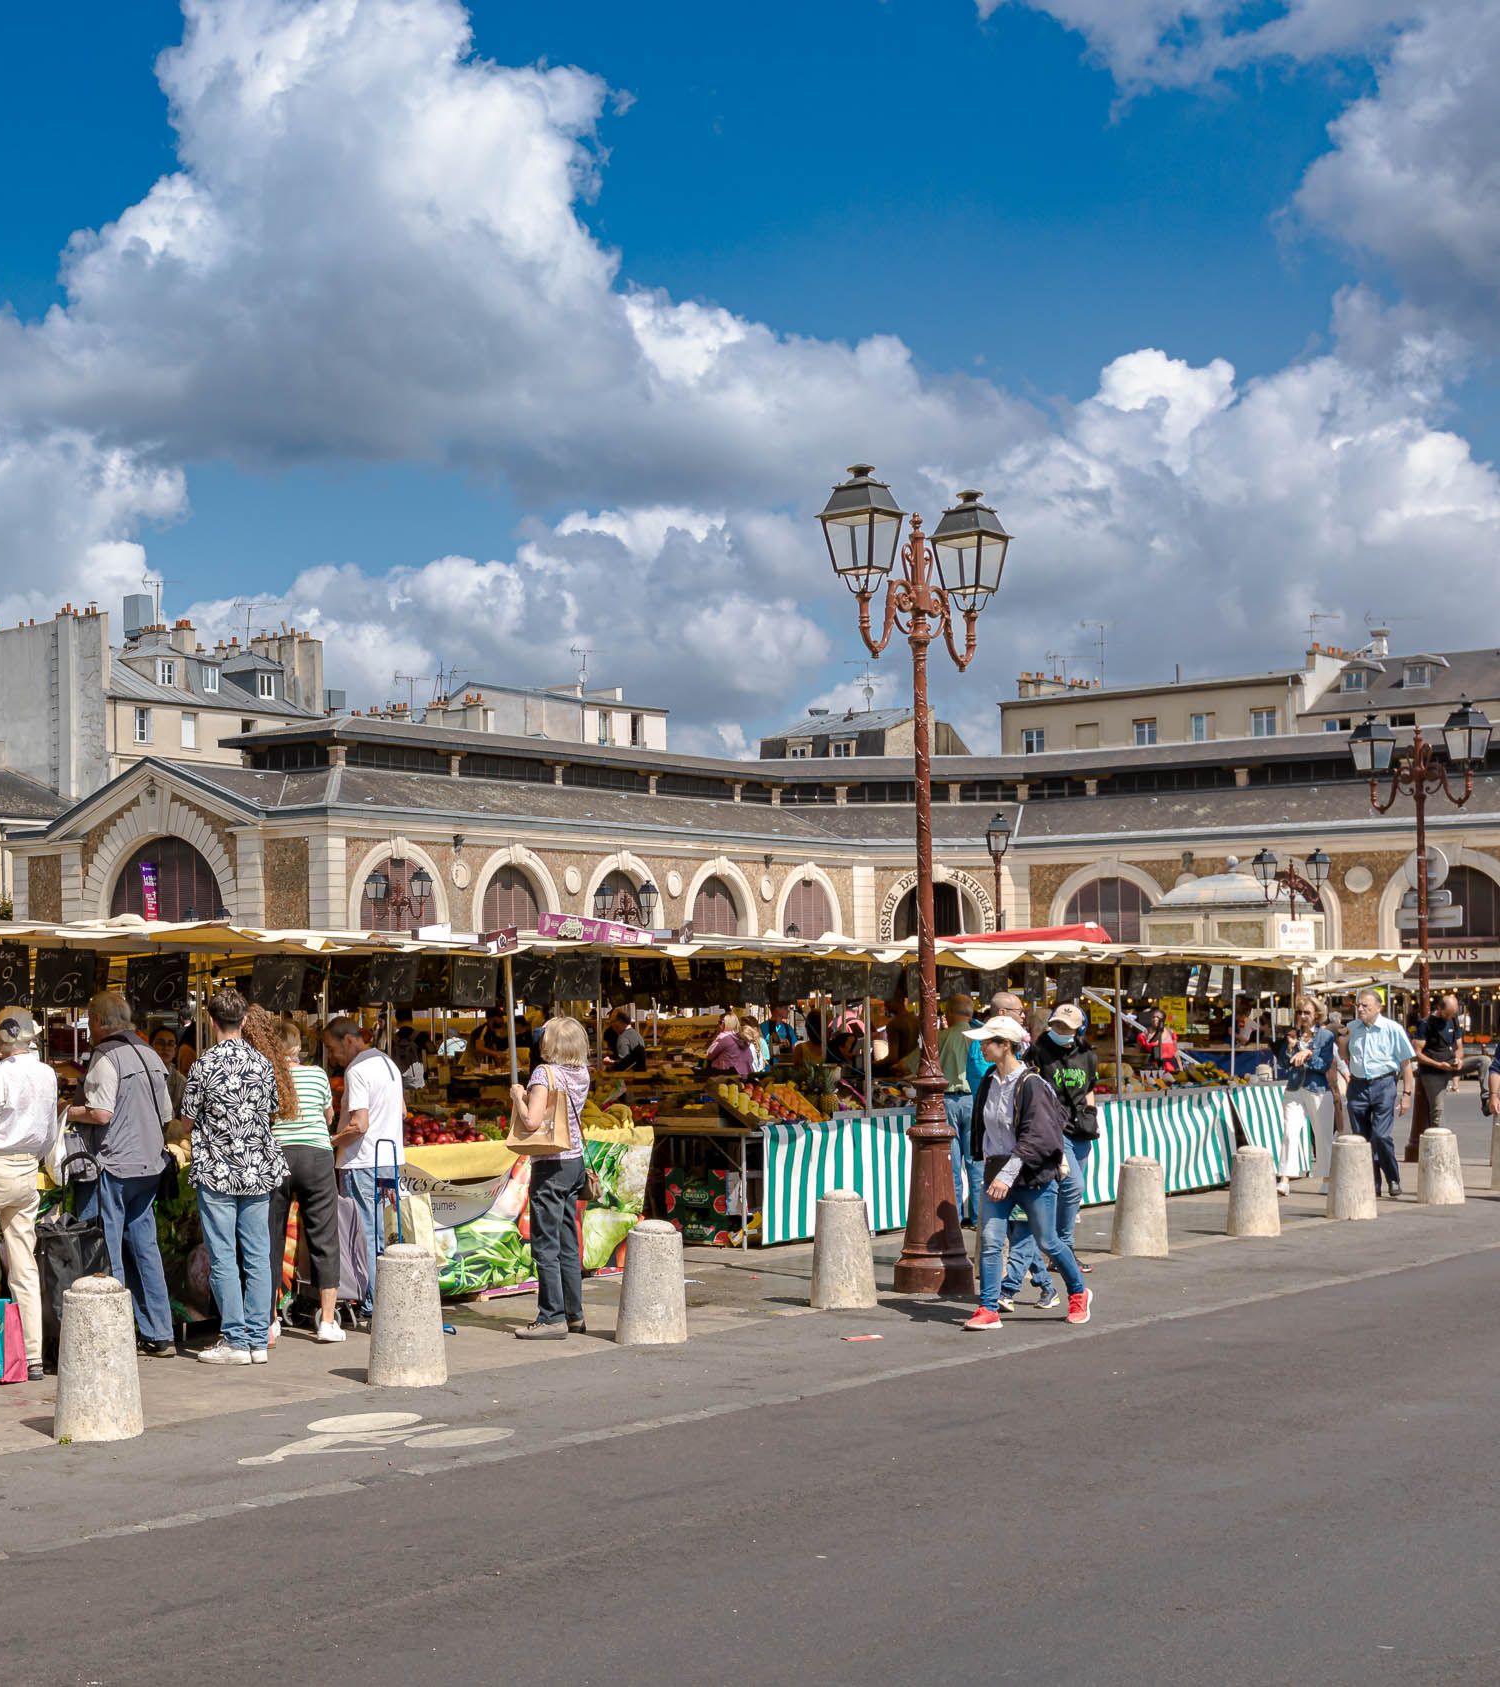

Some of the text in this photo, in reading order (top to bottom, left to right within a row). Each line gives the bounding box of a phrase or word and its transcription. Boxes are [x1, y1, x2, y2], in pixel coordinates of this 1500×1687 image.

[881, 893, 898, 942] ASSAGE
[948, 870, 995, 933] ANTIQUAIR
[1434, 949, 1479, 961] VINS
[399, 1169, 428, 1191] ères
[432, 1201, 457, 1214] gumes
